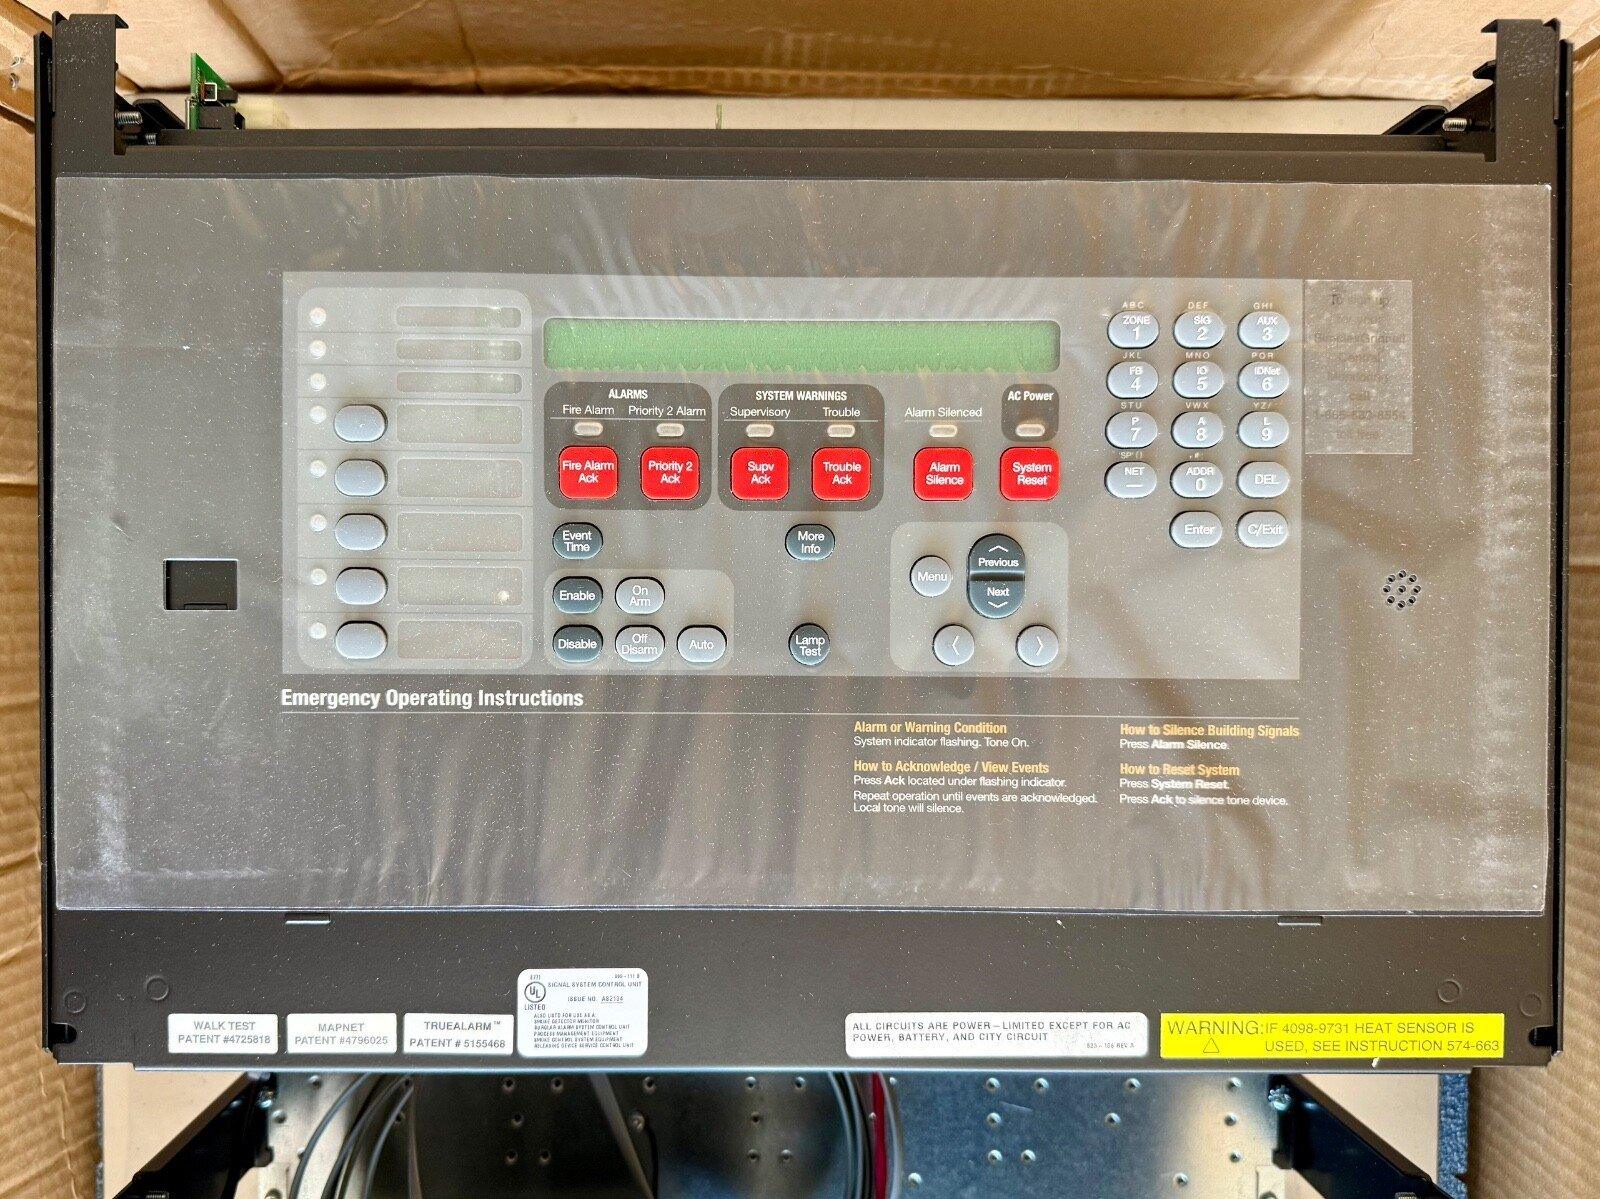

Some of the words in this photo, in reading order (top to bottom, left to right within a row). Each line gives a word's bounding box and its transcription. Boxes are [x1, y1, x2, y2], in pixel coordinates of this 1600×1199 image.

[1122, 315, 1151, 325] ZONE
[1193, 315, 1212, 325] SIG
[1256, 316, 1279, 326] AUX
[1196, 326, 1209, 341] 2
[1130, 376, 1142, 392] 4
[1196, 376, 1208, 391] 5
[1261, 376, 1272, 392] 6
[608, 388, 648, 400] ALARMS
[755, 390, 795, 401] SYSTEM
[796, 390, 848, 402] WARNINGS
[1007, 391, 1022, 401] AC
[1023, 391, 1054, 401] Power
[562, 404, 582, 415] Fire
[583, 404, 615, 415] Alarm
[628, 404, 665, 418] Priority
[676, 406, 707, 416] Alarm
[730, 406, 791, 420] Supervisory
[822, 406, 861, 418] Trouble
[904, 407, 935, 418] Alarm
[938, 407, 983, 418] Silenced
[1130, 427, 1141, 442] 7
[1195, 427, 1207, 442] 8
[1261, 427, 1272, 442] 9
[562, 460, 582, 472] Fire
[584, 460, 615, 472] Alarm
[648, 461, 684, 474] Priority
[747, 462, 775, 474] Supv
[822, 462, 862, 472] Trouble
[929, 462, 961, 472] Alarm
[1012, 462, 1053, 475] System
[1124, 467, 1145, 476] NET
[1186, 467, 1214, 476] ADDR
[578, 473, 599, 484] Ack
[660, 473, 681, 484] Ack
[751, 474, 772, 485] Ack
[832, 474, 852, 485] Ack
[925, 474, 965, 486] Silence
[1017, 475, 1048, 486] Reset
[1254, 474, 1281, 485] DEL
[1184, 524, 1216, 535] Enter
[1247, 523, 1284, 536] C/Exit
[562, 530, 592, 541] Event
[797, 531, 825, 542] More
[564, 542, 591, 552] Time
[801, 544, 821, 554] Info
[978, 558, 1019, 567] Previous
[917, 572, 948, 582] Menu
[559, 590, 596, 601] Enable
[632, 585, 648, 596] On
[987, 587, 1010, 597] Next
[629, 596, 651, 607] Arm
[558, 638, 597, 650] Disable
[632, 633, 648, 644] Off
[795, 635, 826, 648] Lamp
[621, 644, 658, 655] Disarm
[689, 640, 714, 650] Auto
[799, 646, 822, 657] Test
[281, 688, 381, 710] Emergency
[386, 688, 473, 710] Operating
[478, 689, 584, 707] Instructions
[854, 721, 888, 733] Alarm
[888, 724, 902, 733] or
[904, 722, 951, 736] Warning
[954, 722, 1008, 734] Condition
[1120, 724, 1145, 735] How
[1149, 724, 1161, 735] to
[1163, 724, 1205, 736] Silence
[1208, 724, 1255, 739] Building
[1257, 725, 1300, 739] Signals
[853, 736, 892, 750] System
[894, 737, 938, 747] indicator
[940, 737, 982, 750] flashing.
[984, 737, 1009, 748] Tone
[1011, 738, 1030, 748] On.
[1120, 739, 1150, 749] Press
[1151, 739, 1185, 750] Alarm
[1186, 739, 1230, 750] Silence.
[853, 760, 879, 772] How
[881, 761, 893, 772] to
[895, 760, 971, 775] Acknowledge
[981, 761, 1010, 774] View
[1011, 762, 1050, 774] Events
[1120, 763, 1145, 775] How
[1148, 764, 1161, 775] to
[1163, 764, 1195, 776] Reset
[1197, 764, 1240, 778] System
[853, 775, 882, 786] Press
[884, 775, 906, 786] Ack
[907, 776, 945, 786] located
[947, 776, 977, 787] under
[979, 776, 1019, 789] flashing
[1021, 777, 1067, 788] indicator.
[1120, 778, 1149, 789] Press
[1151, 779, 1194, 791] System
[853, 791, 890, 804] Repeat
[892, 792, 940, 804] operation
[942, 792, 964, 802] until
[965, 793, 999, 802] events
[1001, 794, 1018, 803] are
[1020, 793, 1098, 806] acknowledged.
[1120, 794, 1149, 804] Press
[1150, 794, 1176, 805] Ack
[1175, 796, 1186, 805] to
[1188, 794, 1224, 805] silence
[1226, 796, 1251, 805] tone
[1252, 795, 1289, 806] device.
[853, 803, 881, 813] Local
[882, 804, 906, 813] tone
[907, 803, 924, 813] will
[926, 804, 964, 814] silence.
[193, 1022, 226, 1031] WALK
[228, 1022, 256, 1031] TEST
[318, 1023, 365, 1032] MAPNET
[853, 1022, 872, 1031] ALL
[875, 1022, 924, 1030] CIRCUITS
[927, 1022, 948, 1030] ARE
[1049, 1022, 1088, 1030] EXCEPT
[1092, 1022, 1114, 1030] FOR
[1117, 1022, 1131, 1030] AC
[1167, 1020, 1264, 1035] WARNING:
[1265, 1023, 1278, 1034] IF
[1282, 1022, 1349, 1034] 4098-9731
[1355, 1022, 1393, 1034] HEAT
[1397, 1022, 1457, 1034] SENSOR
[1461, 1022, 1475, 1034] IS
[178, 1034, 221, 1044] PATENT
[222, 1035, 271, 1044] #4725818
[294, 1036, 337, 1045] PATENT
[339, 1036, 389, 1045] #4796025
[853, 1033, 894, 1042] POWER,
[898, 1033, 949, 1042] BATTERY,
[953, 1033, 975, 1041] AND
[979, 1033, 1002, 1041] CITY
[1006, 1032, 1048, 1041] CIRCUIT
[409, 1038, 453, 1048] PATENT
[464, 1039, 506, 1048] 5155468
[1265, 1040, 1308, 1053] USED,
[1312, 1040, 1341, 1052] SEE
[1345, 1040, 1443, 1052] INSTRUCTION
[1447, 1040, 1499, 1052] 574-663
